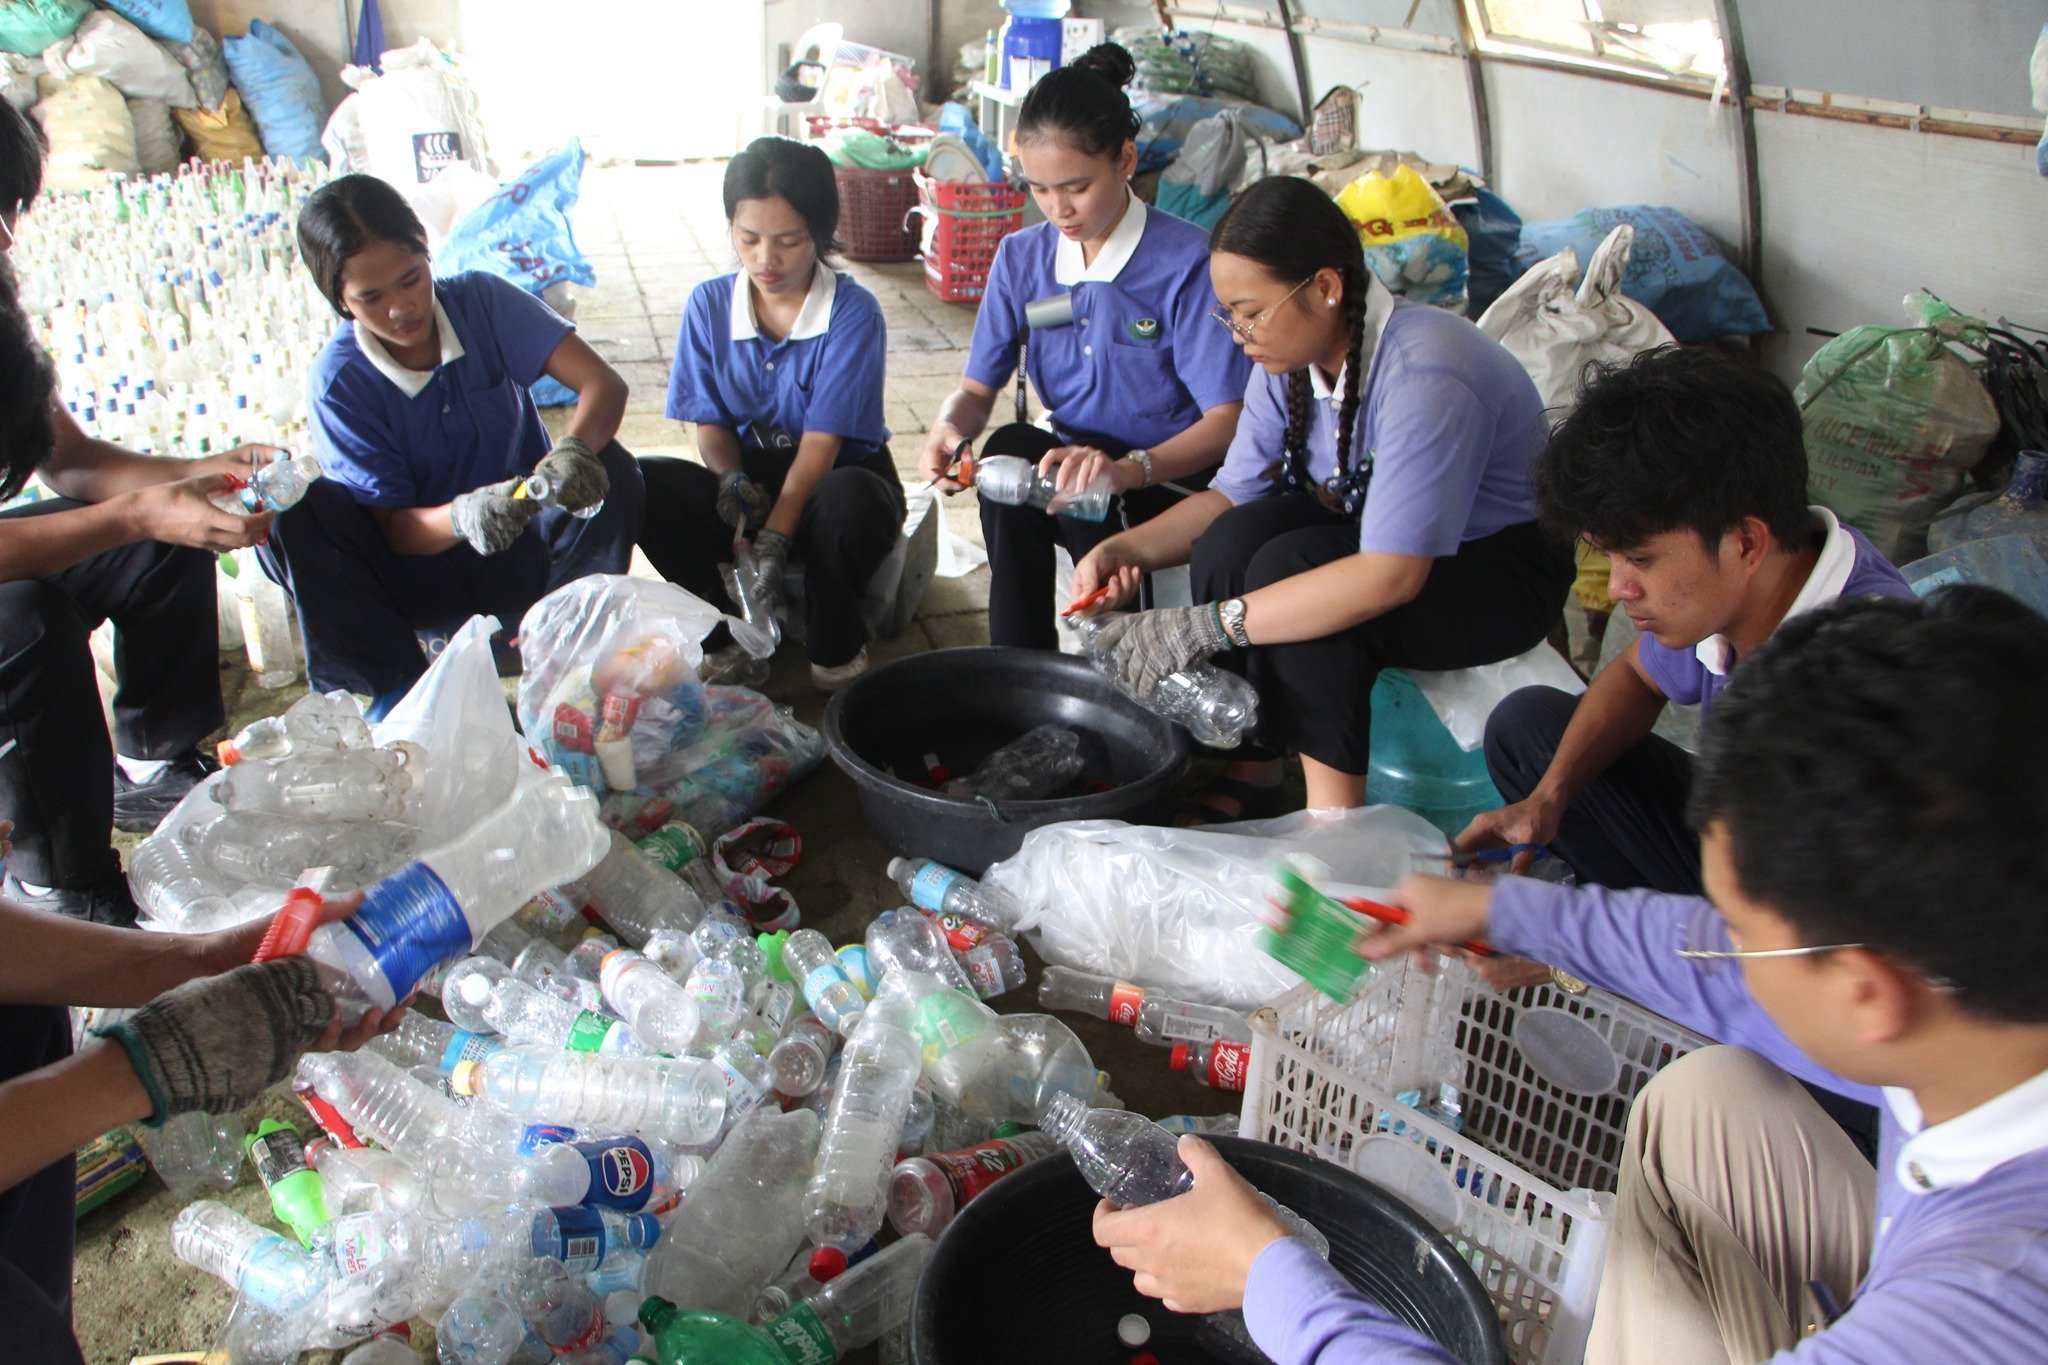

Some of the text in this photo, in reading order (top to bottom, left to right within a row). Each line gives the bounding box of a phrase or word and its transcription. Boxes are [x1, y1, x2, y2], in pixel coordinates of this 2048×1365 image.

[1813, 417, 1865, 448] RICE
[617, 1149, 632, 1194] PEPSI
[976, 1148, 1005, 1172] C2
